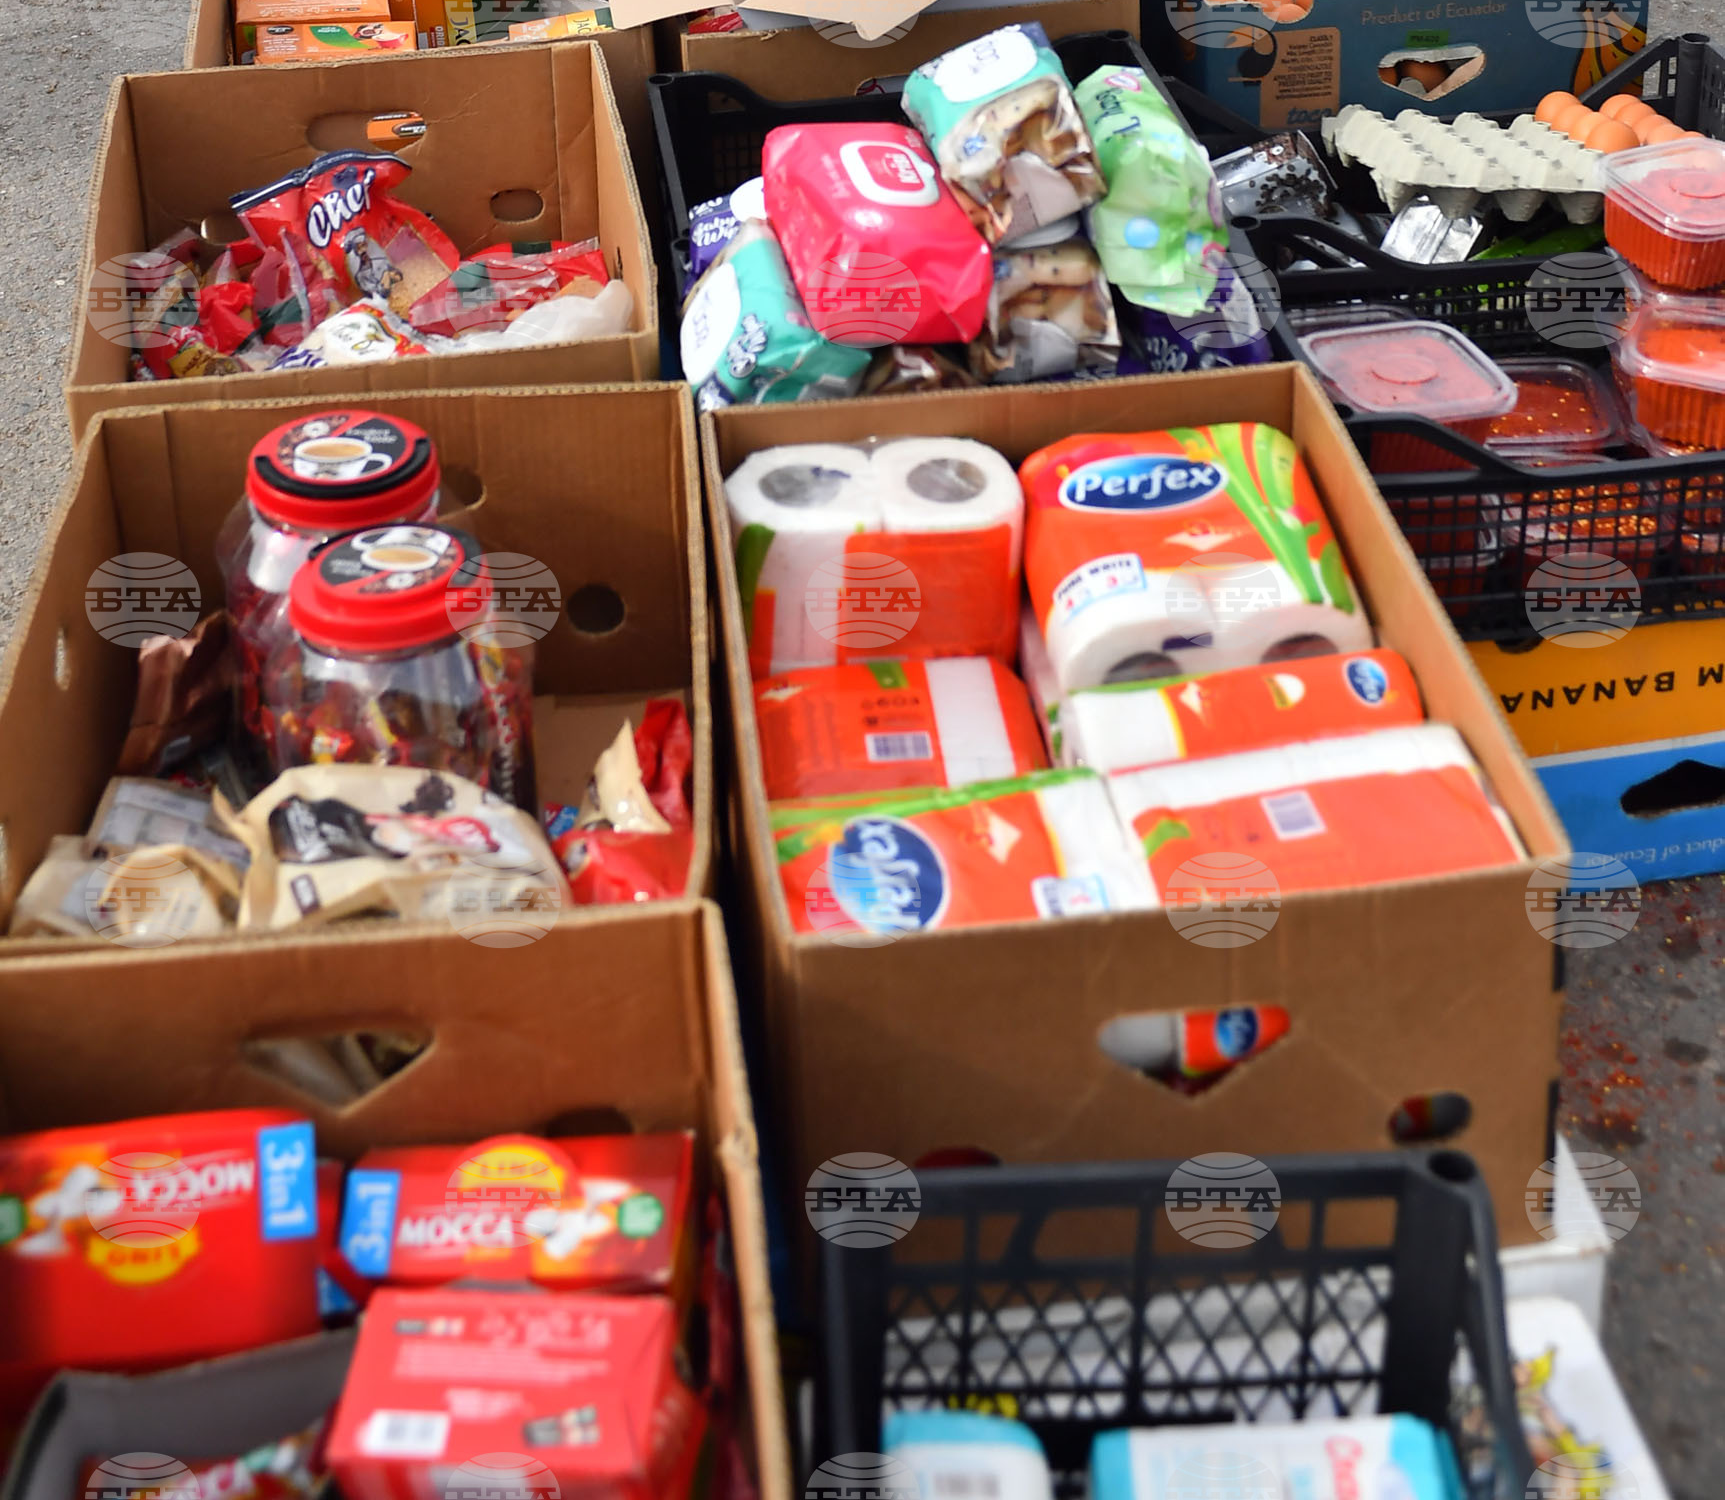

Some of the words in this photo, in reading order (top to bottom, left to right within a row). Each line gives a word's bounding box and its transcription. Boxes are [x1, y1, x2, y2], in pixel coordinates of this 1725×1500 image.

[1361, 8, 1421, 26] Product
[1425, 5, 1442, 20] of
[1445, 1, 1508, 19] Ecuador
[1074, 463, 1216, 502] Perfex
[1500, 671, 1676, 714] BANANA
[1662, 844, 1681, 860] of
[132, 1160, 255, 1202] MOCCA
[399, 1214, 515, 1248] MOCCA
